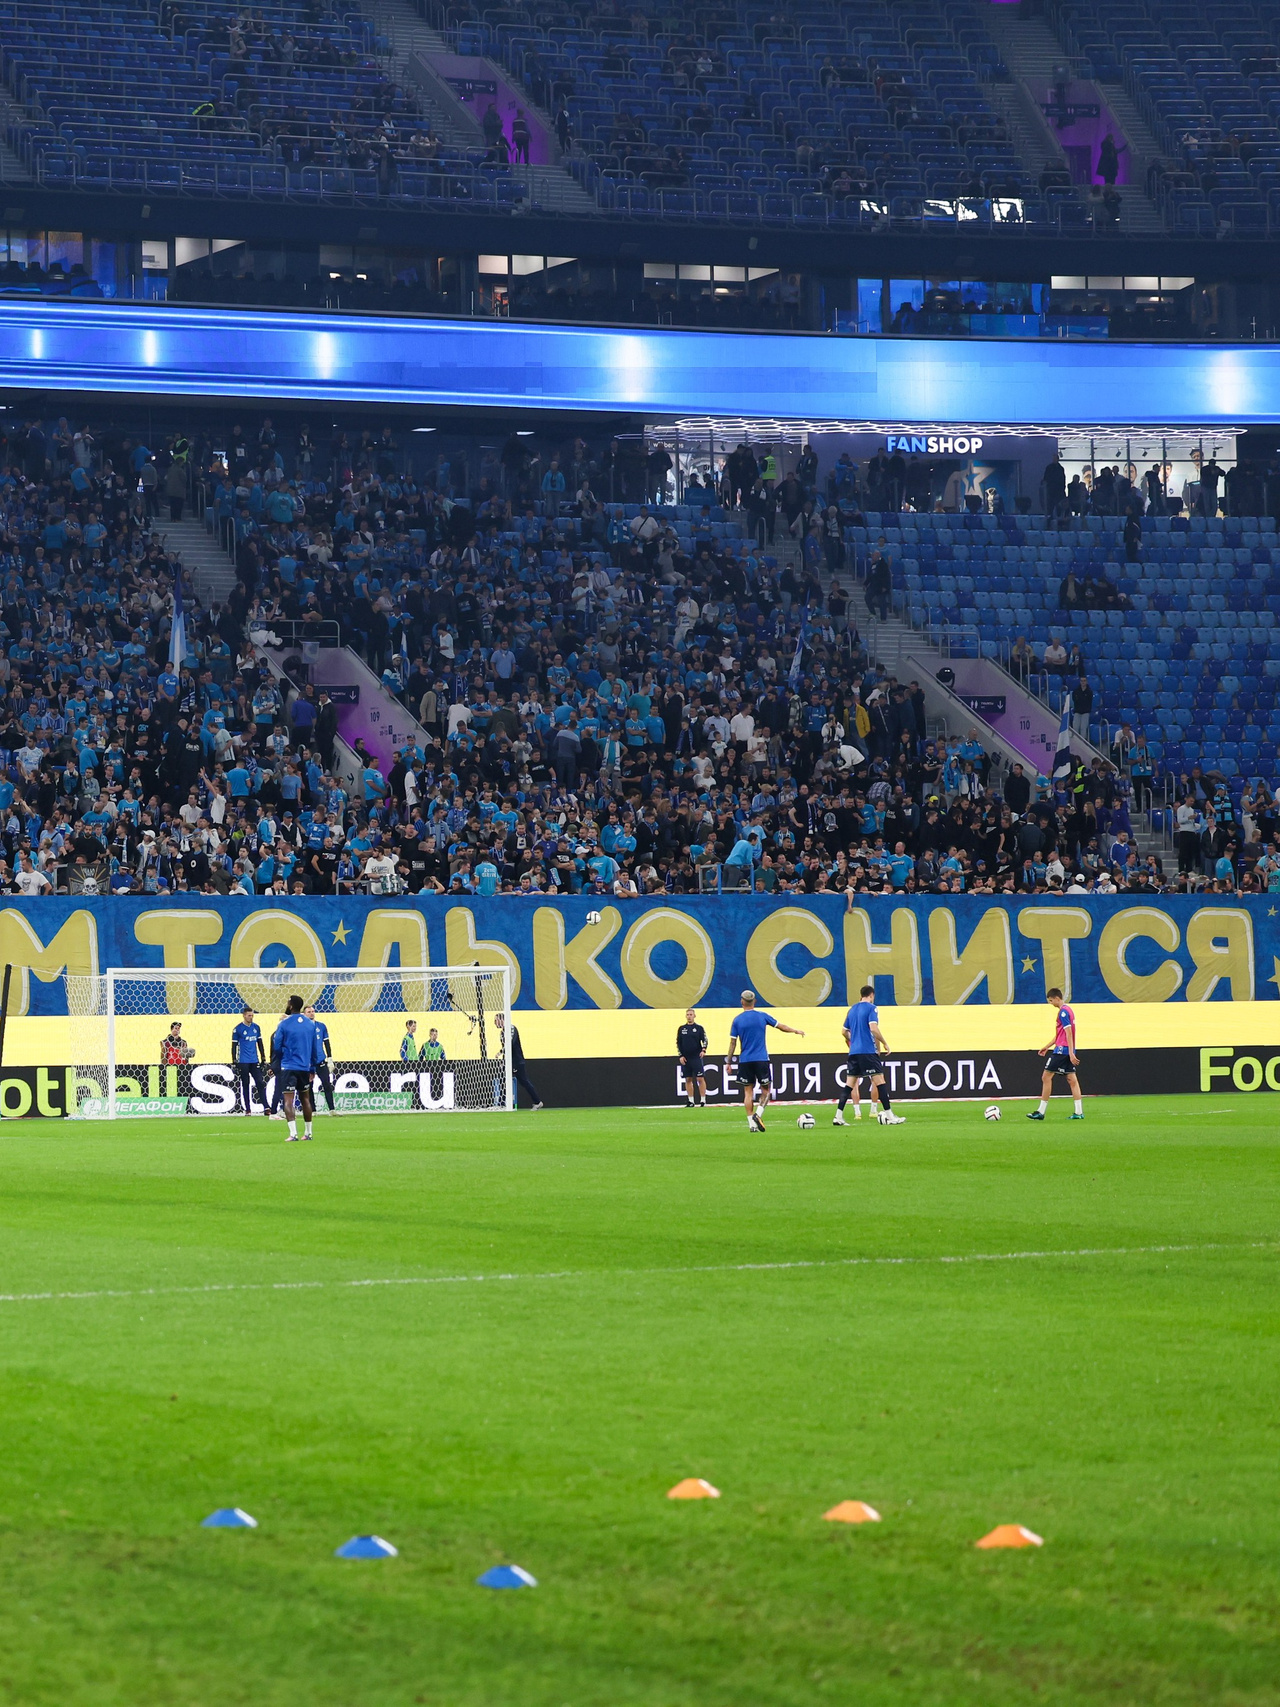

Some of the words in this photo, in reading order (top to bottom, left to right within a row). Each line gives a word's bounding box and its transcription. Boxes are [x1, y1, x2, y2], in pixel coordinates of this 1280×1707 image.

[887, 436, 983, 454] FANSHOP
[370, 711, 380, 723] 109
[1019, 720, 1030, 731] 110
[133, 906, 716, 1016] ТОЛЬКО
[745, 906, 1256, 1008] СНИТСЯ
[835, 1058, 1003, 1094] ТБОЛА
